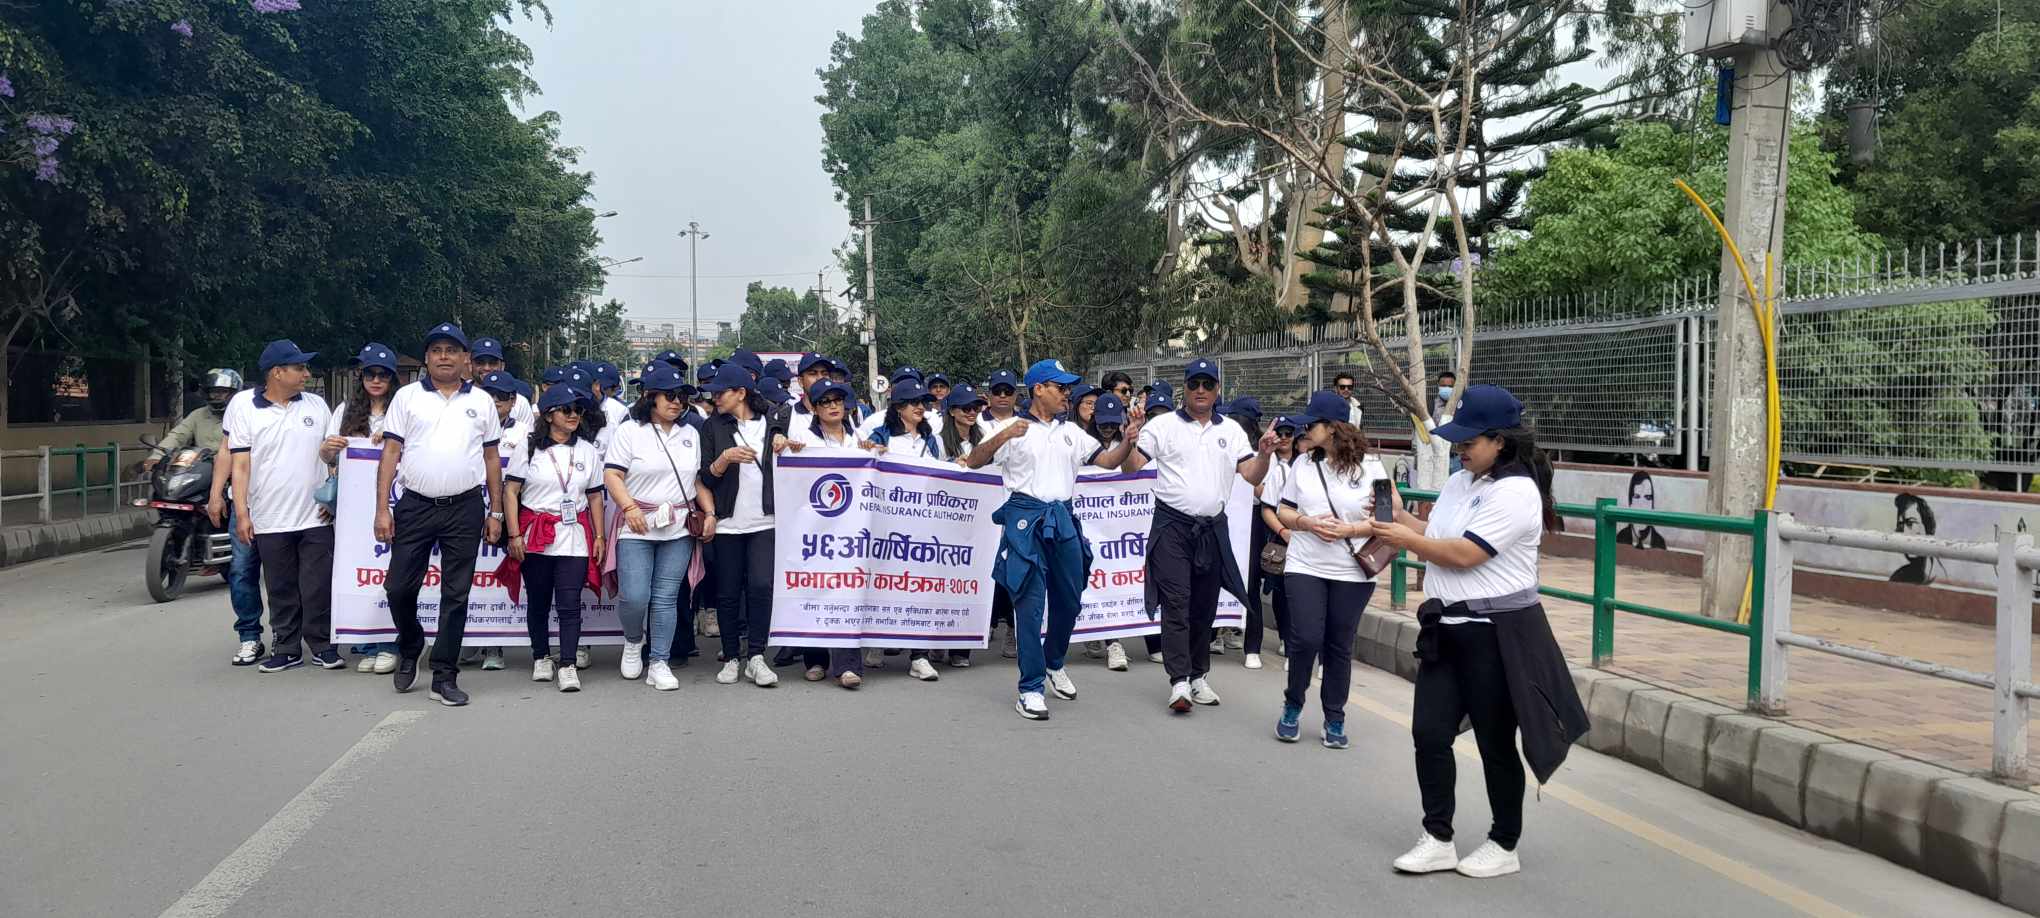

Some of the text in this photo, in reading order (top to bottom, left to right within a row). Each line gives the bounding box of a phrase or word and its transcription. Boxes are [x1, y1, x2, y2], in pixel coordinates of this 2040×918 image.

[889, 486, 922, 505] बीमा
[926, 490, 978, 511] प्राधिकरण
[1074, 491, 1149, 509] नेपाल बीमा
[859, 502, 974, 522] NEPA NSURANCE AUTHORITY
[1107, 508, 1156, 519] INSURANC
[1099, 532, 1149, 560] वार्षि
